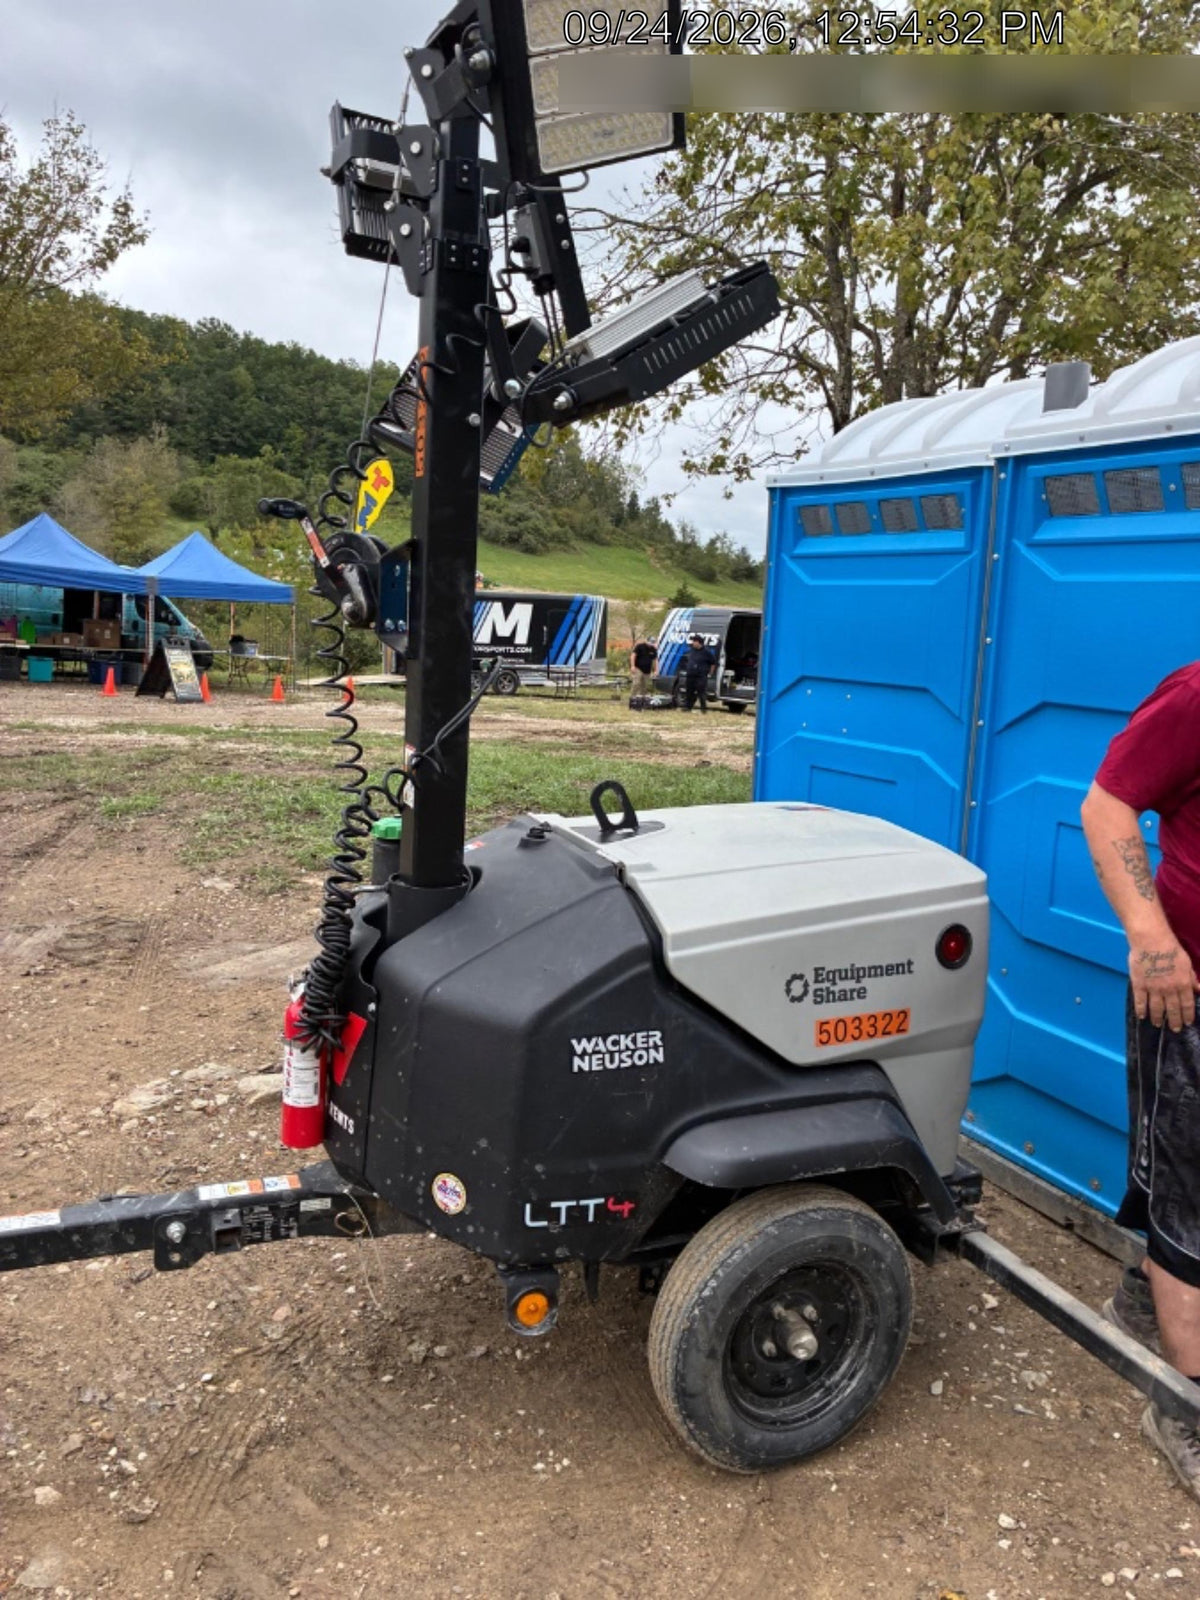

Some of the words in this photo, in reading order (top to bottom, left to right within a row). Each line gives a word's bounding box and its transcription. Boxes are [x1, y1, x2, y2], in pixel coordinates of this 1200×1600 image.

[813, 958, 915, 986] Equipment
[812, 985, 868, 1005] Share
[818, 1009, 909, 1046] 503322
[570, 1030, 664, 1055] WACKER
[572, 1046, 665, 1073] NEUSON
